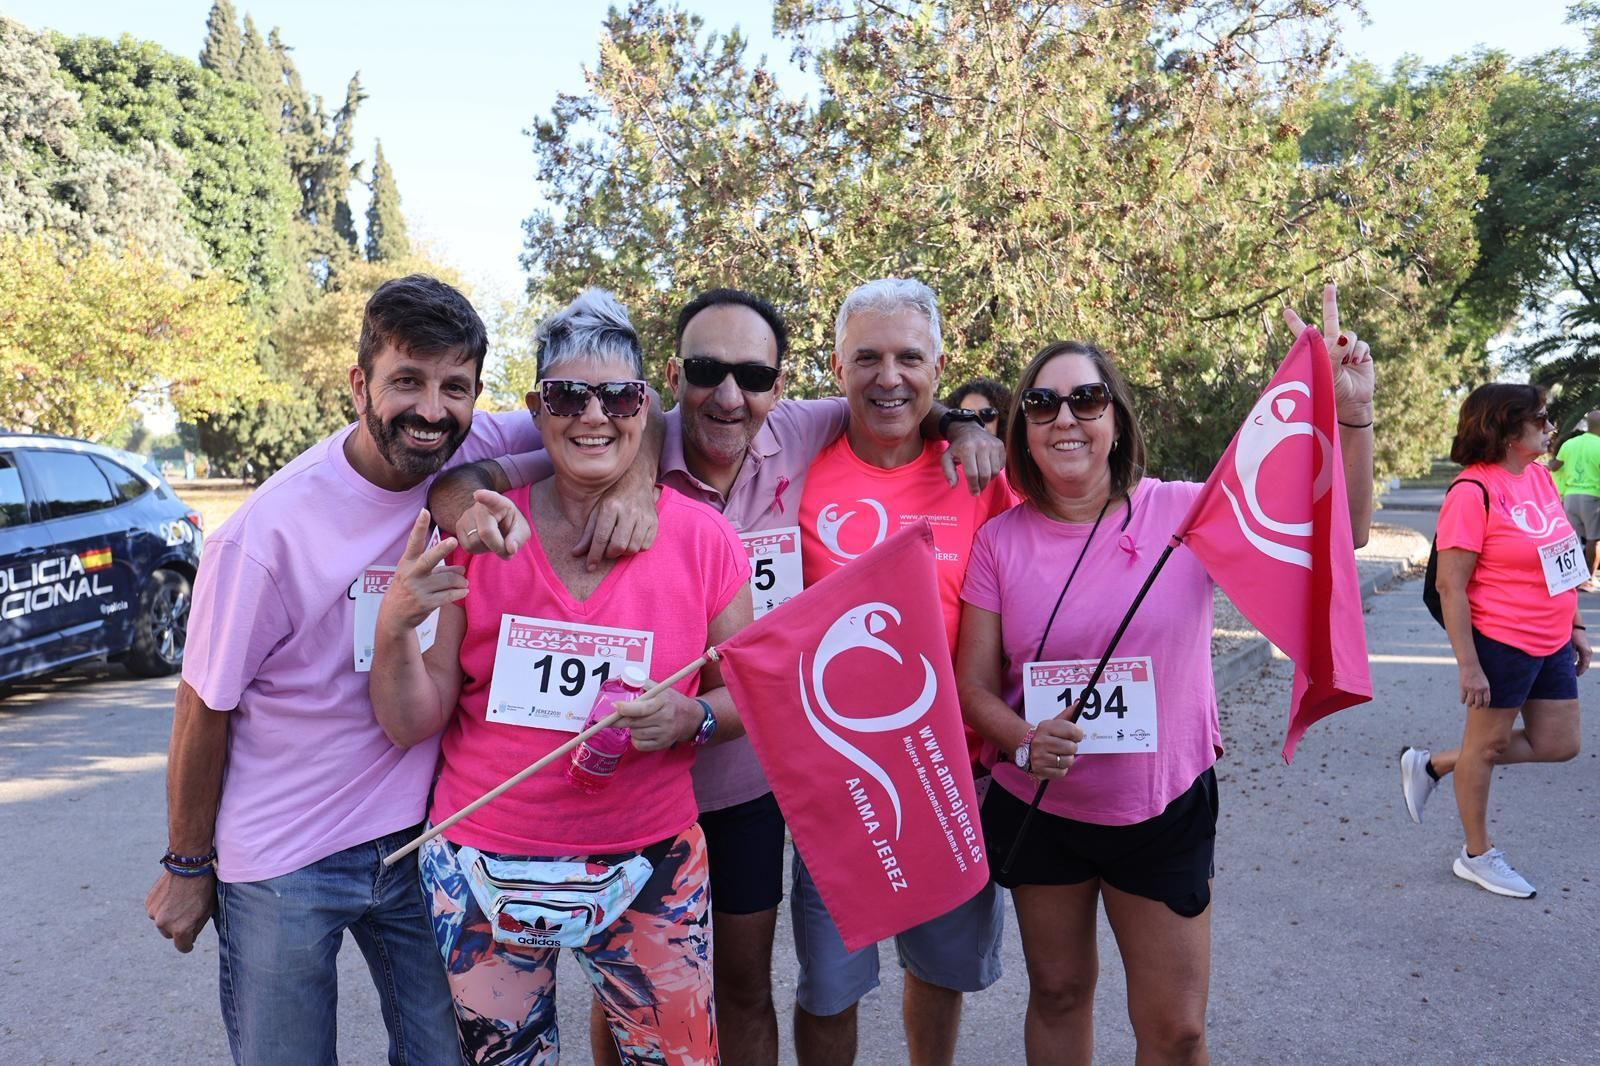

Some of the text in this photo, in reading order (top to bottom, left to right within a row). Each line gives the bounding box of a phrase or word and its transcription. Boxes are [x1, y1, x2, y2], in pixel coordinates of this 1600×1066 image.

[743, 534, 791, 548] RCHA
[755, 558, 776, 591] 5
[1556, 548, 1577, 573] 167
[0, 574, 113, 620] CIONAL
[510, 629, 532, 640] III
[538, 631, 642, 647] MARCHA
[511, 638, 578, 652] ROSA
[534, 654, 611, 697] 191
[1032, 671, 1050, 680] III
[1035, 674, 1091, 686] ROSA
[1057, 685, 1128, 720] 194
[902, 735, 921, 768] Mujeres
[918, 725, 983, 863] www.ammajerez.es
[846, 777, 908, 892] AMMA JEREZ
[518, 937, 561, 946] adidas
